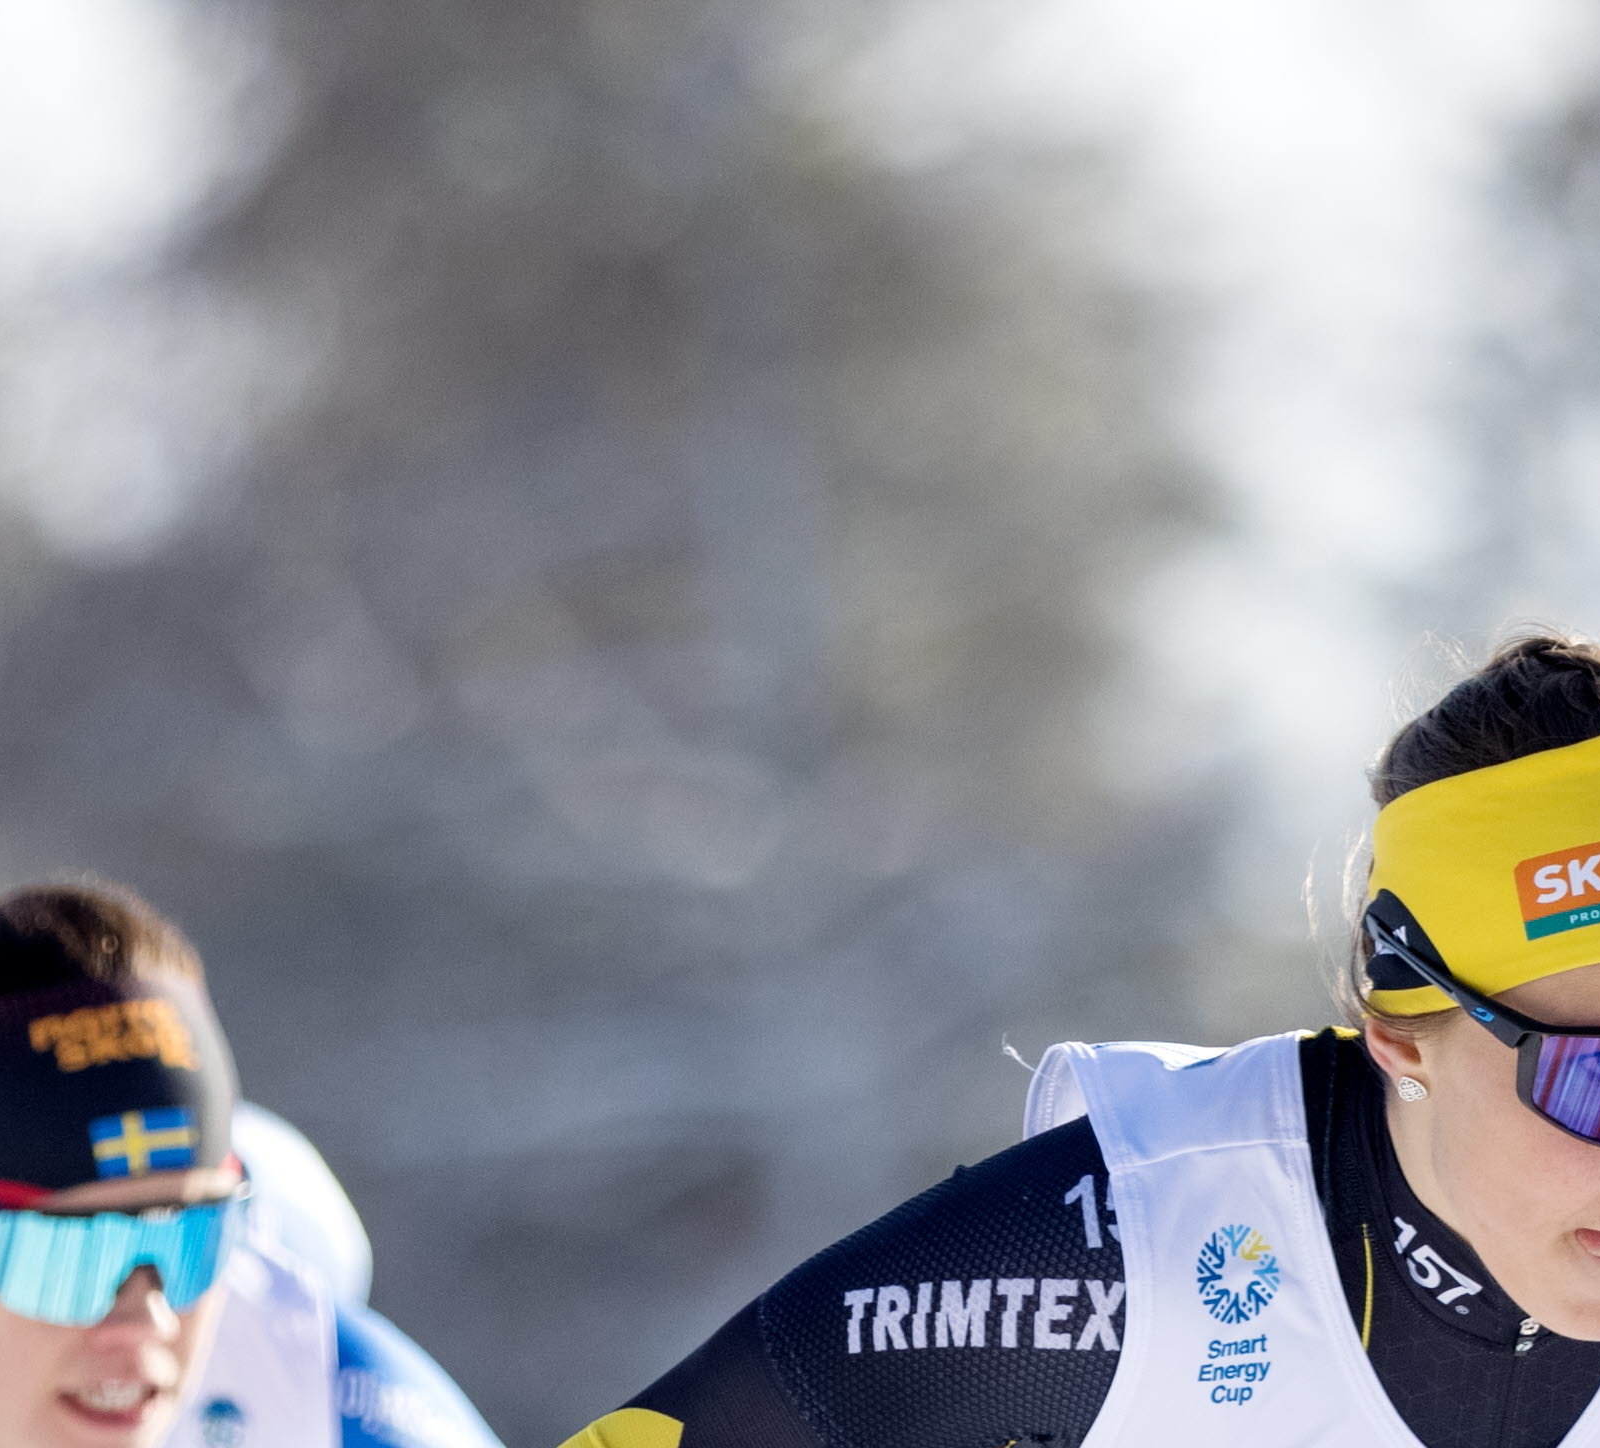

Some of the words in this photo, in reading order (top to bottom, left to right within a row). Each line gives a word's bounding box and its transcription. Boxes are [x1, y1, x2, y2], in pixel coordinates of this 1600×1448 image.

[1394, 1216, 1483, 1306] 157
[844, 1278, 1125, 1354] TRIMTEX
[1207, 1334, 1267, 1360] Smart
[1198, 1358, 1270, 1385] Energy
[1210, 1384, 1253, 1406] Cup
